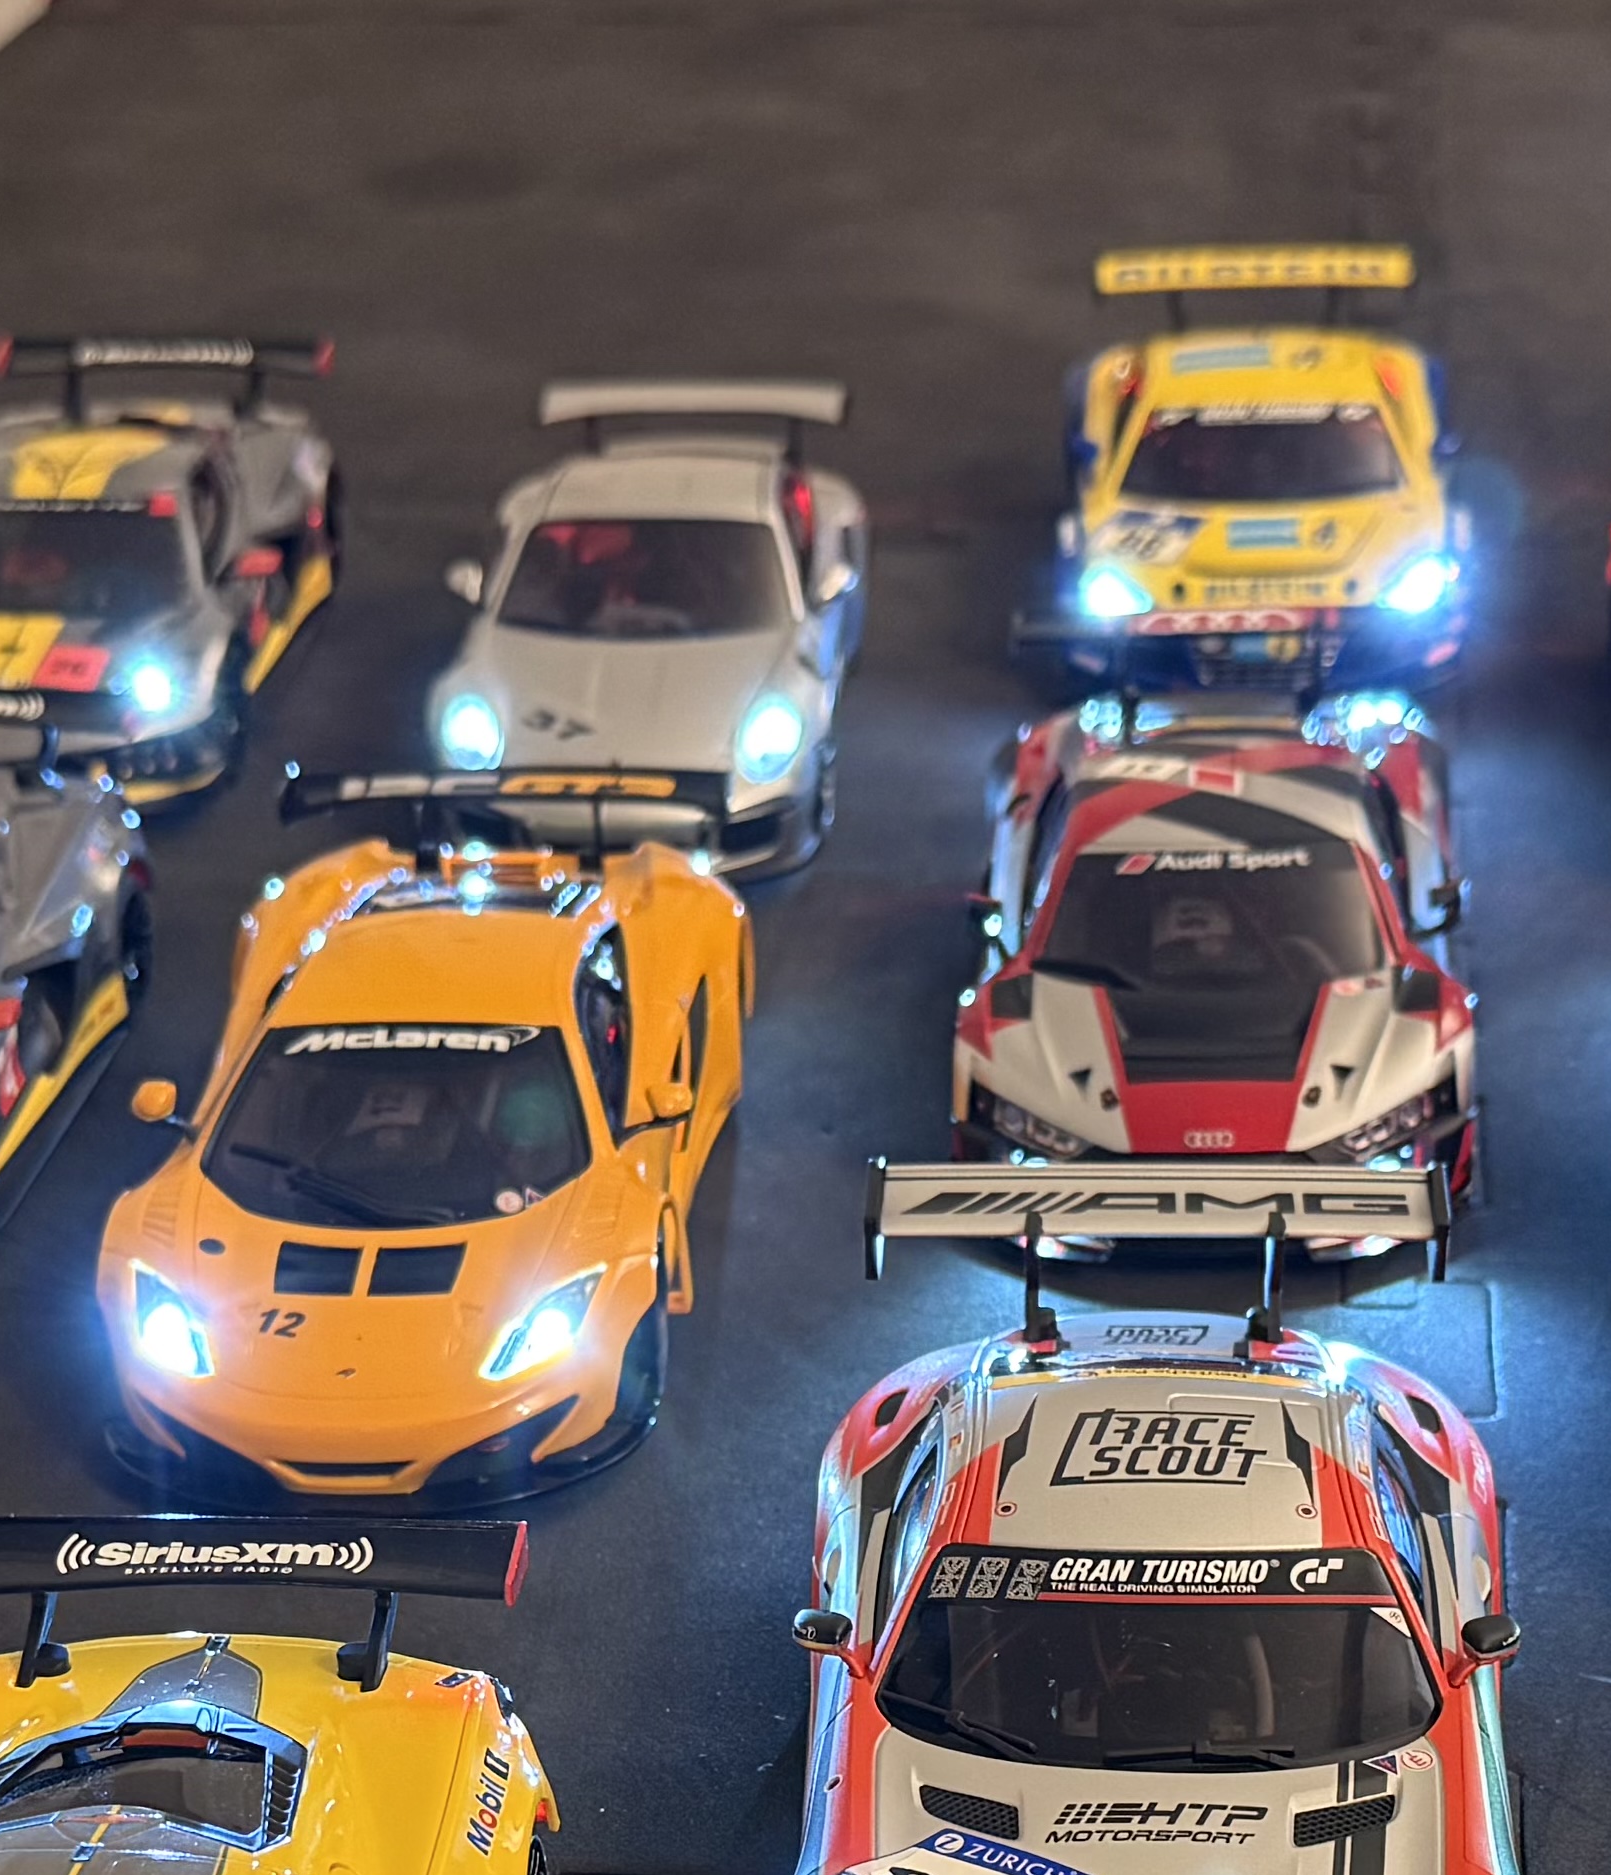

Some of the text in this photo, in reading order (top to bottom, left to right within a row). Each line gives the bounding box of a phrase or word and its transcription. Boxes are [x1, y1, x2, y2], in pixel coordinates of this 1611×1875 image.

[1154, 849, 1312, 873] Audi Sport
[284, 1028, 511, 1055] McLaren
[1062, 1191, 1411, 1217] AMG
[258, 1307, 307, 1339] 12
[1088, 1409, 1253, 1448] RACE
[1087, 1445, 1268, 1479] SCOUT
[124, 1565, 294, 1575] SATELLITE RADIO
[1049, 1557, 1138, 1583] GRAN
[1141, 1558, 1270, 1585] TURISMO
[1049, 1581, 1257, 1595] THE REAL DRIVING SIMULATOR
[466, 1772, 508, 1857] Mobil
[1044, 1828, 1257, 1846] MOTORSPORT
